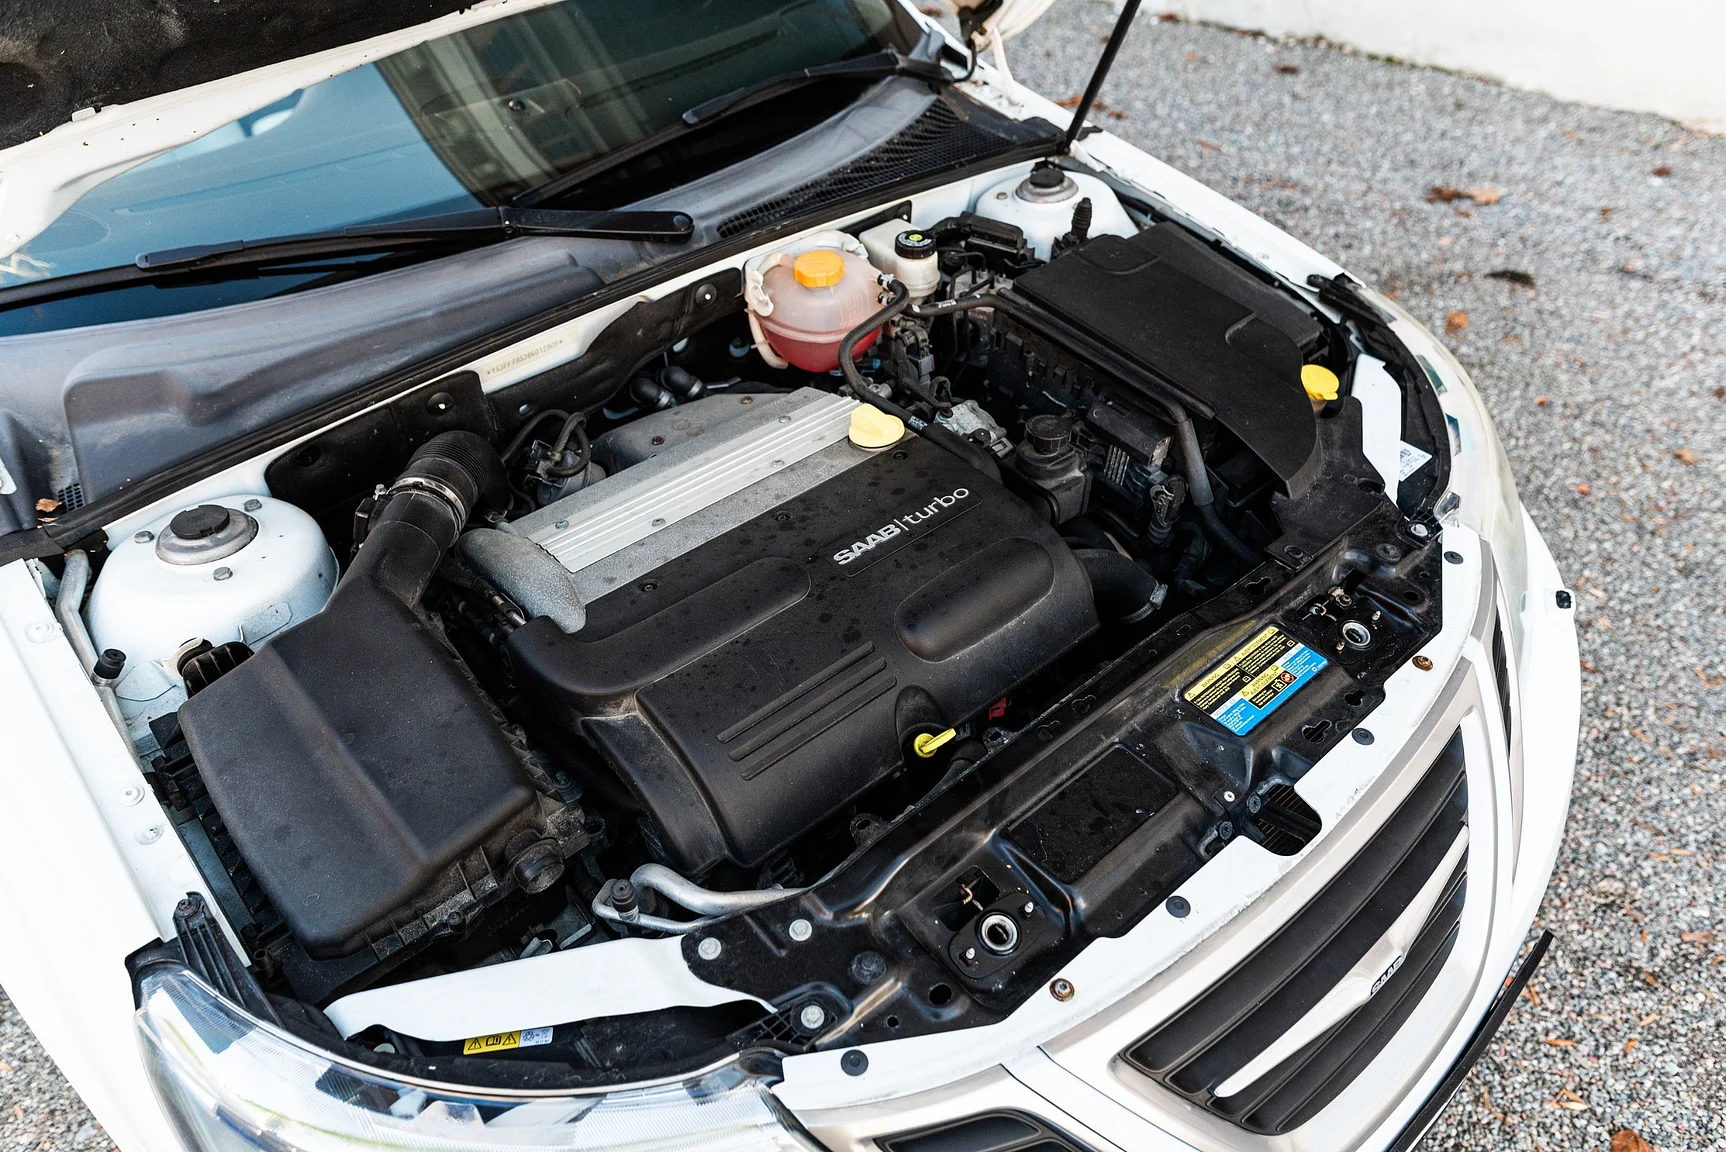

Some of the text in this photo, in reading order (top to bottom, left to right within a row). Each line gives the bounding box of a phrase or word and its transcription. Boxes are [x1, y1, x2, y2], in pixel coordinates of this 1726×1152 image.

[833, 488, 969, 565] SAAB turbo
[1371, 956, 1403, 996] SAAB
